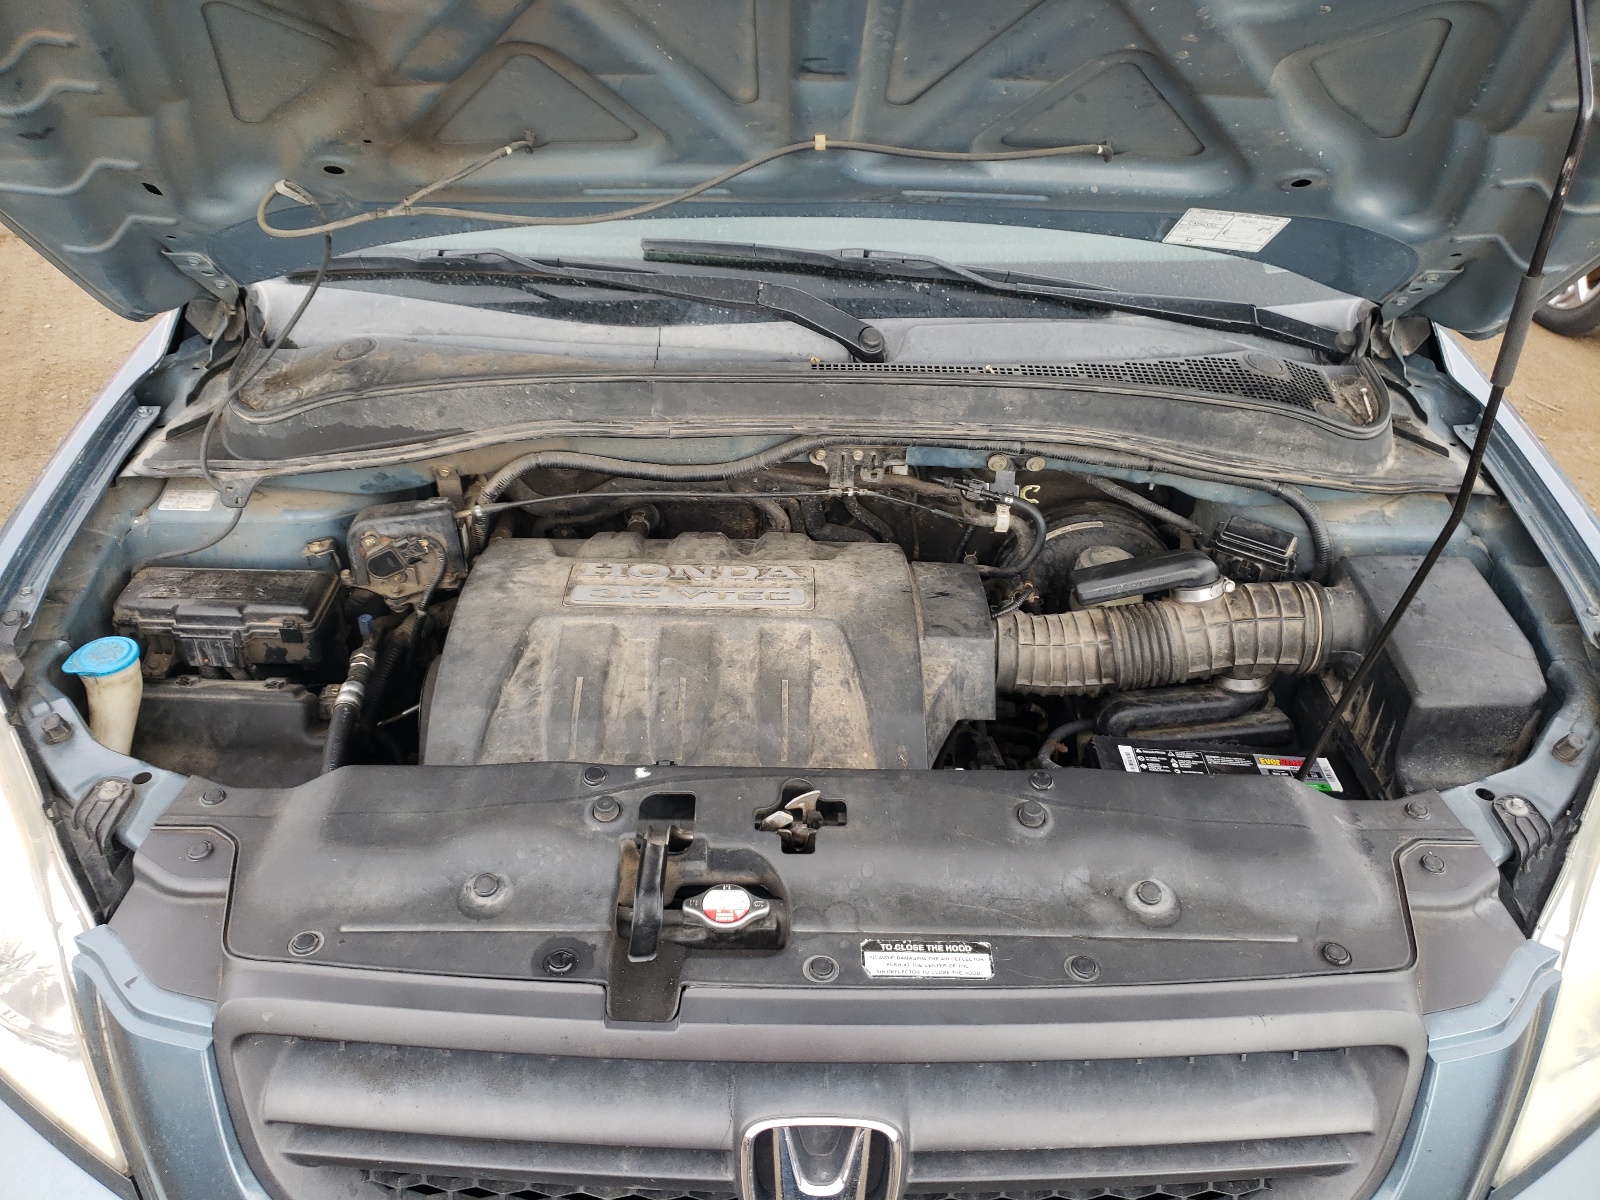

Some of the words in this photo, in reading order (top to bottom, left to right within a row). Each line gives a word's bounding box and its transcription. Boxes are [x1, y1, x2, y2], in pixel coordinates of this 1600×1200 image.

[574, 563, 806, 581] HONDA
[590, 588, 661, 600] 3.5
[677, 589, 792, 601] VTEC
[880, 943, 892, 951] TO
[894, 943, 925, 951] CLOSE
[926, 944, 944, 952] THE
[945, 944, 972, 952] HOOD
